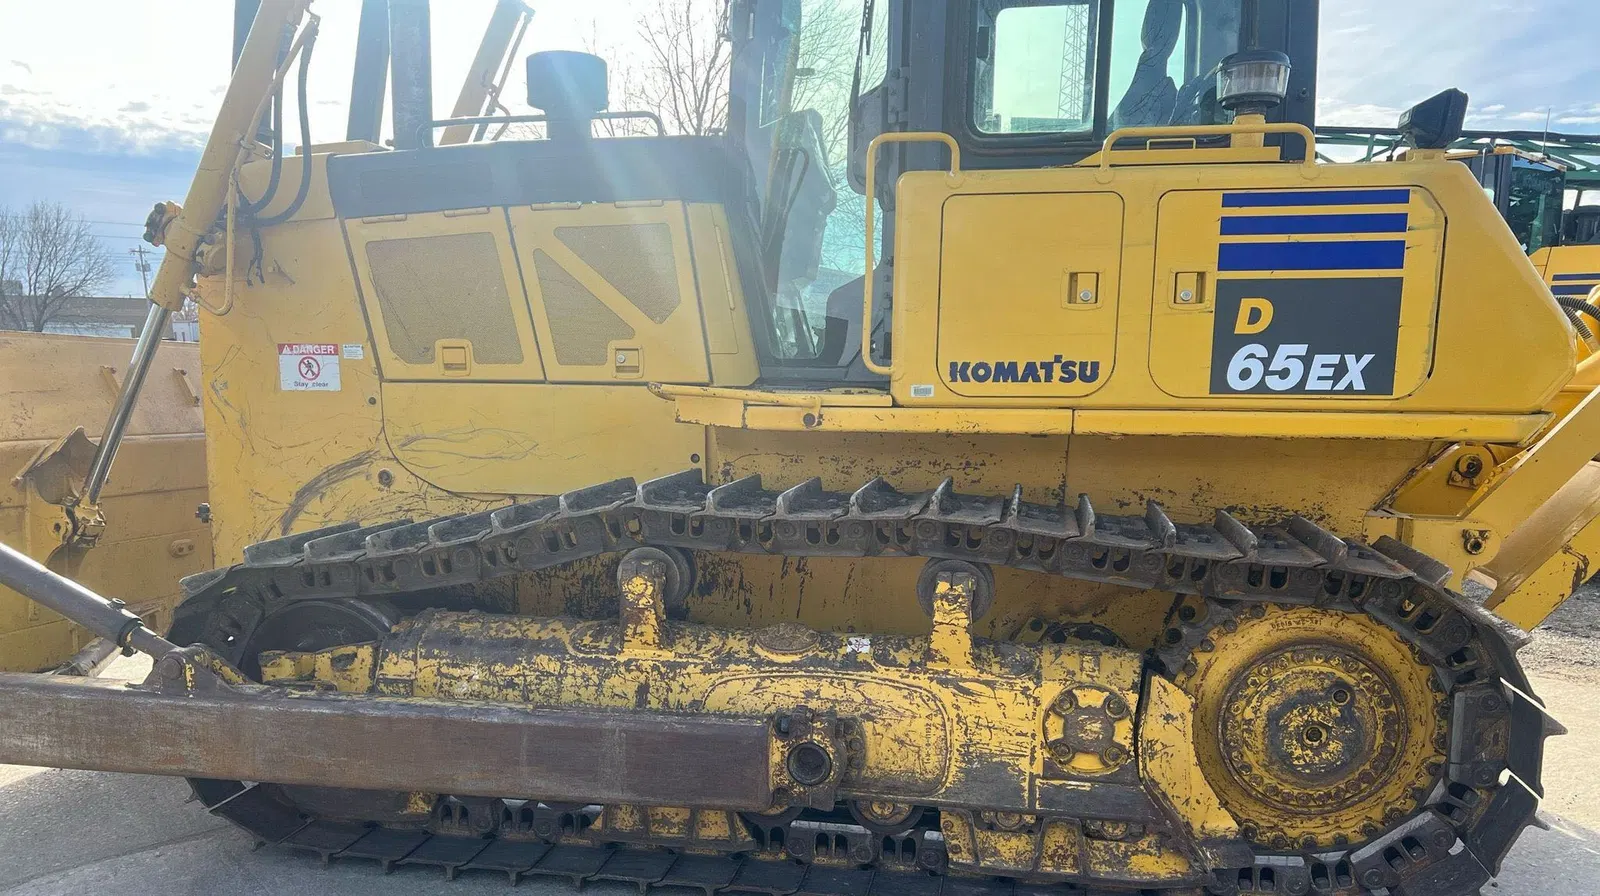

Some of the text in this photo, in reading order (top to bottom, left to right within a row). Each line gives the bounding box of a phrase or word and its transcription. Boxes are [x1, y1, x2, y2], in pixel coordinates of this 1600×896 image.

[1234, 297, 1274, 335] D
[292, 344, 335, 354] DANGER
[949, 354, 1100, 383] KOMATSU
[1226, 343, 1376, 391] 65EX
[293, 380, 309, 388] Stay
